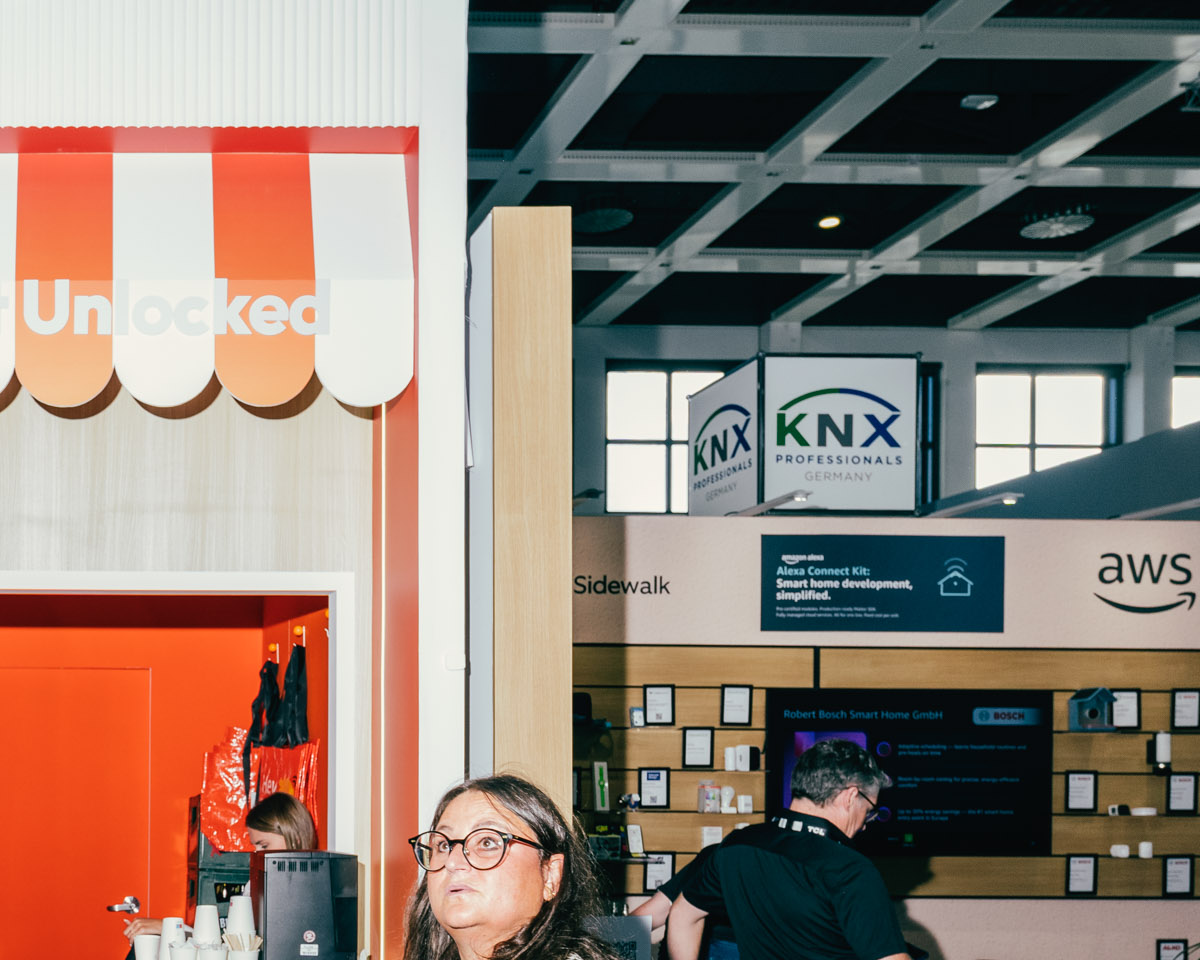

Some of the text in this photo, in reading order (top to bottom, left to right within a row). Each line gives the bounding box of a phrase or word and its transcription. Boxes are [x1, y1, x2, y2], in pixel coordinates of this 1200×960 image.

[23, 278, 330, 335] Unlocked
[776, 413, 901, 448] KNX
[694, 417, 752, 476] KNX
[776, 455, 903, 465] PROFESSIONALS
[693, 458, 753, 491] PROFESSIONALS
[804, 471, 873, 482] GERMANY
[705, 482, 737, 502] GERMANY
[781, 554, 807, 562] amazon
[776, 566, 870, 576] Alexa Connect Kit:
[1098, 552, 1192, 585] aws
[574, 575, 670, 594] Sidewalk
[776, 579, 913, 591] Smart home development,
[776, 591, 831, 602] simplified.
[784, 710, 943, 720] Robert Bosch Smart Home GmbH
[994, 712, 1025, 720] BOSCH
[807, 825, 826, 837] TCL
